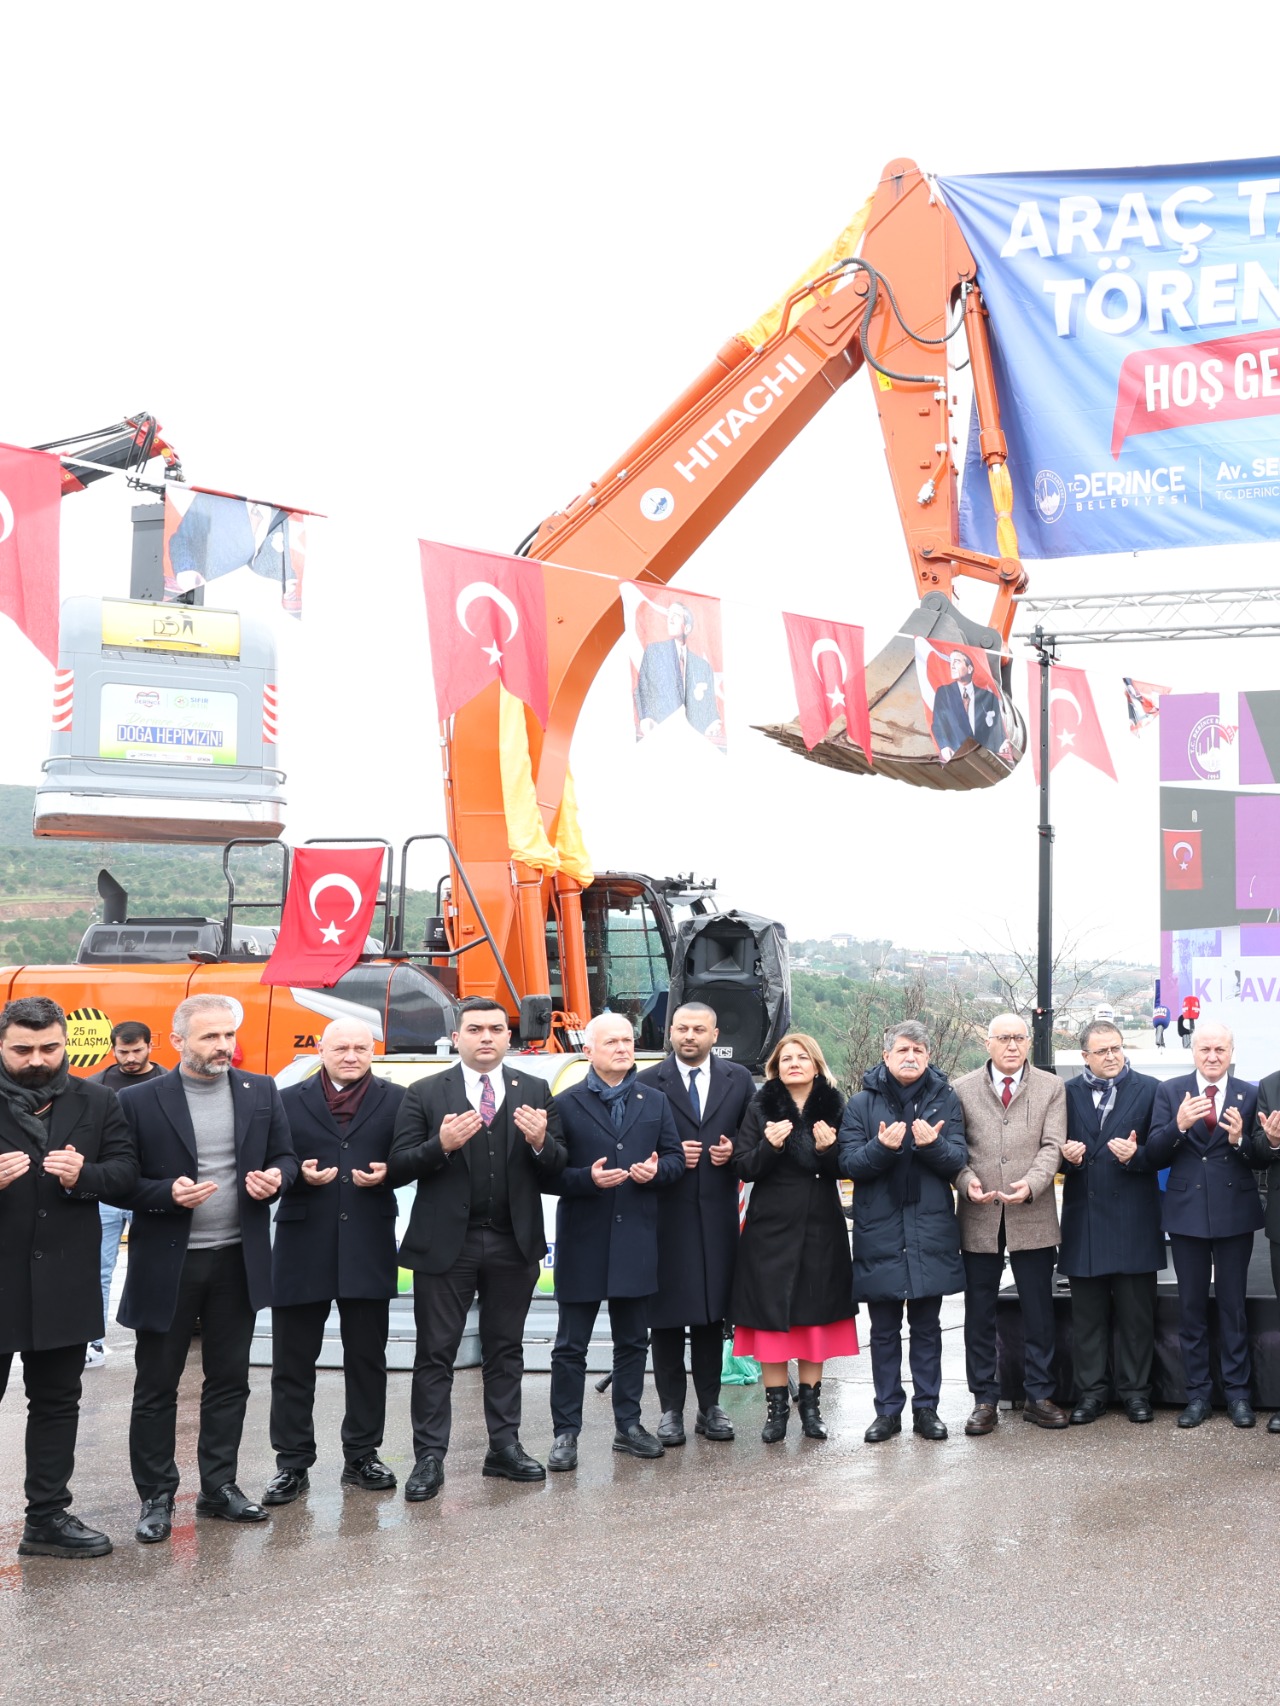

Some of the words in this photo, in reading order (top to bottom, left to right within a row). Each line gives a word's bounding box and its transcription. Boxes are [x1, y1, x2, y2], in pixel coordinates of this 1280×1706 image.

[1000, 186, 1214, 263] ARAÇ
[1144, 359, 1224, 411] HOŞ
[673, 353, 807, 483] HITACHI
[1216, 461, 1248, 480] Av.
[66, 1037, 109, 1048] AKLAŞMA
[73, 1026, 85, 1035] 25
